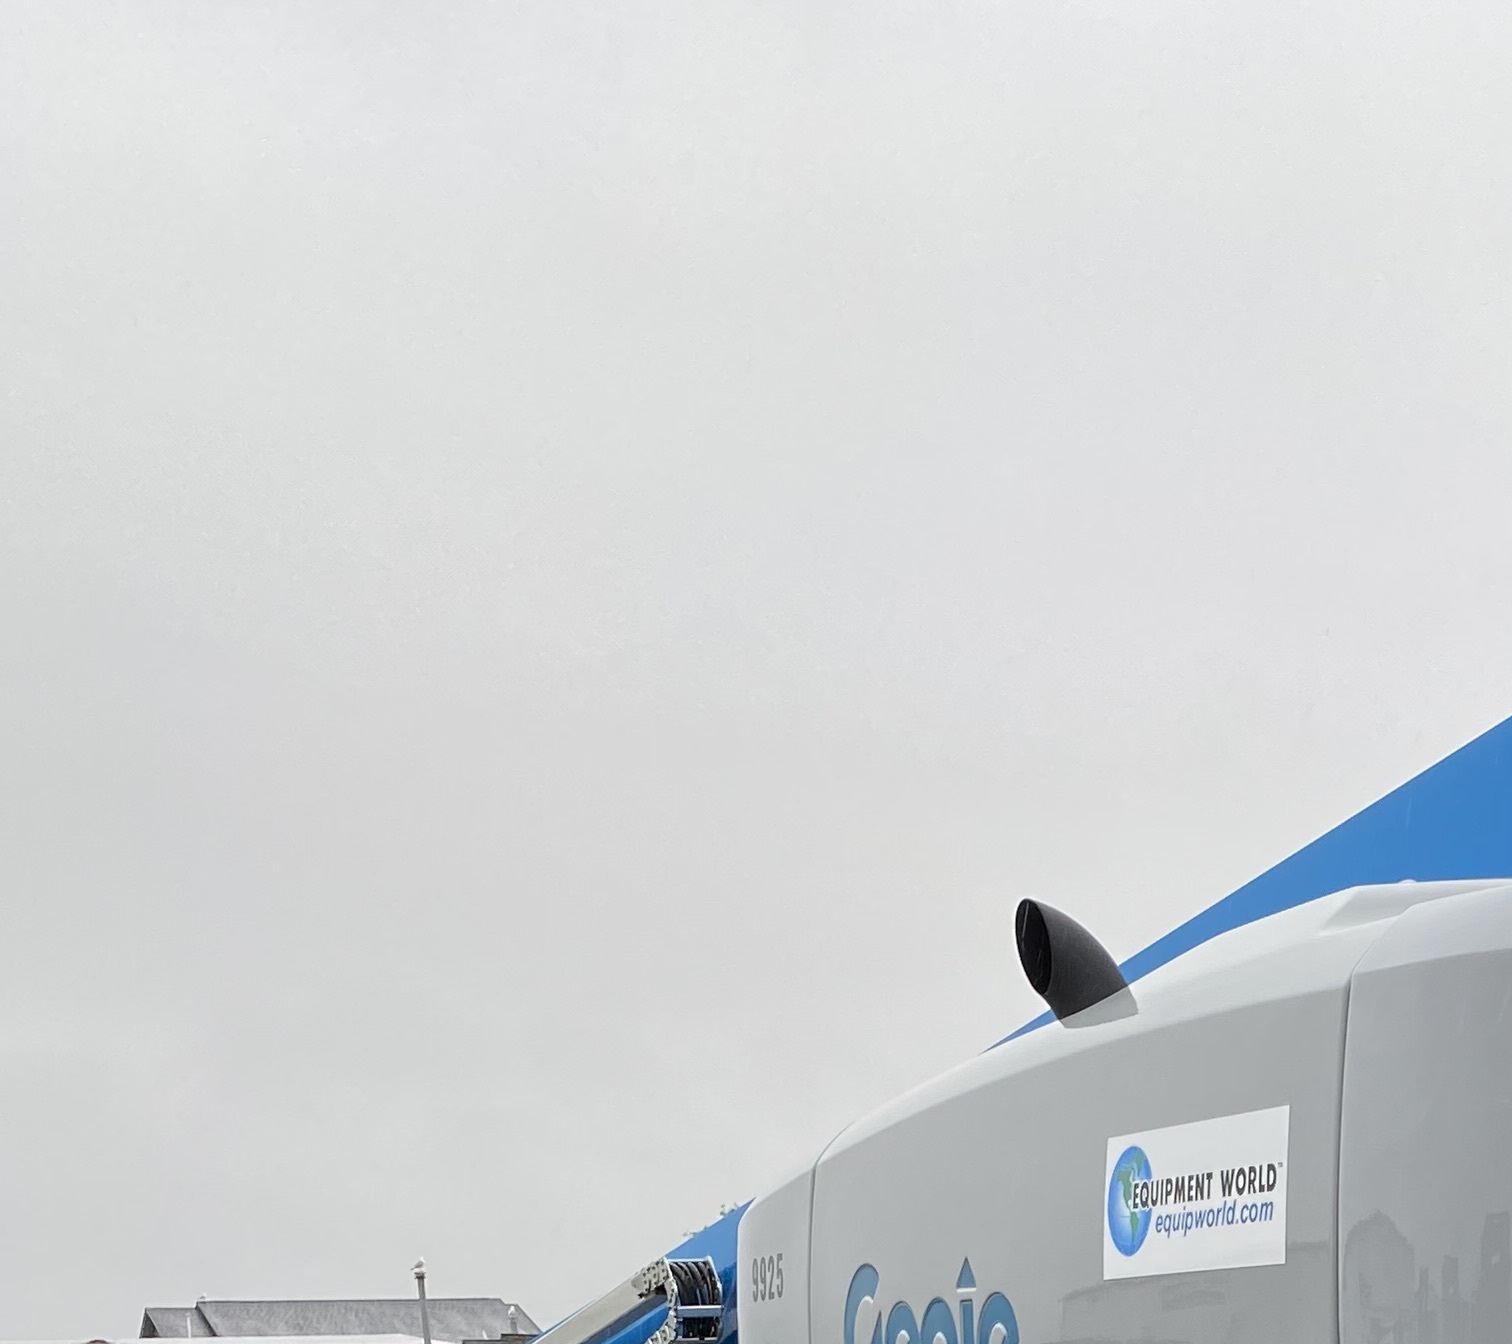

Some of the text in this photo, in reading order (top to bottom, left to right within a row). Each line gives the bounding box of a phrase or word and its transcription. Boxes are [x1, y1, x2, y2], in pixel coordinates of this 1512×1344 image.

[1132, 1163, 1277, 1209] EQUIPMENT WORLD
[1155, 1199, 1274, 1238] equipworld.com
[752, 1253, 783, 1303] 9925
